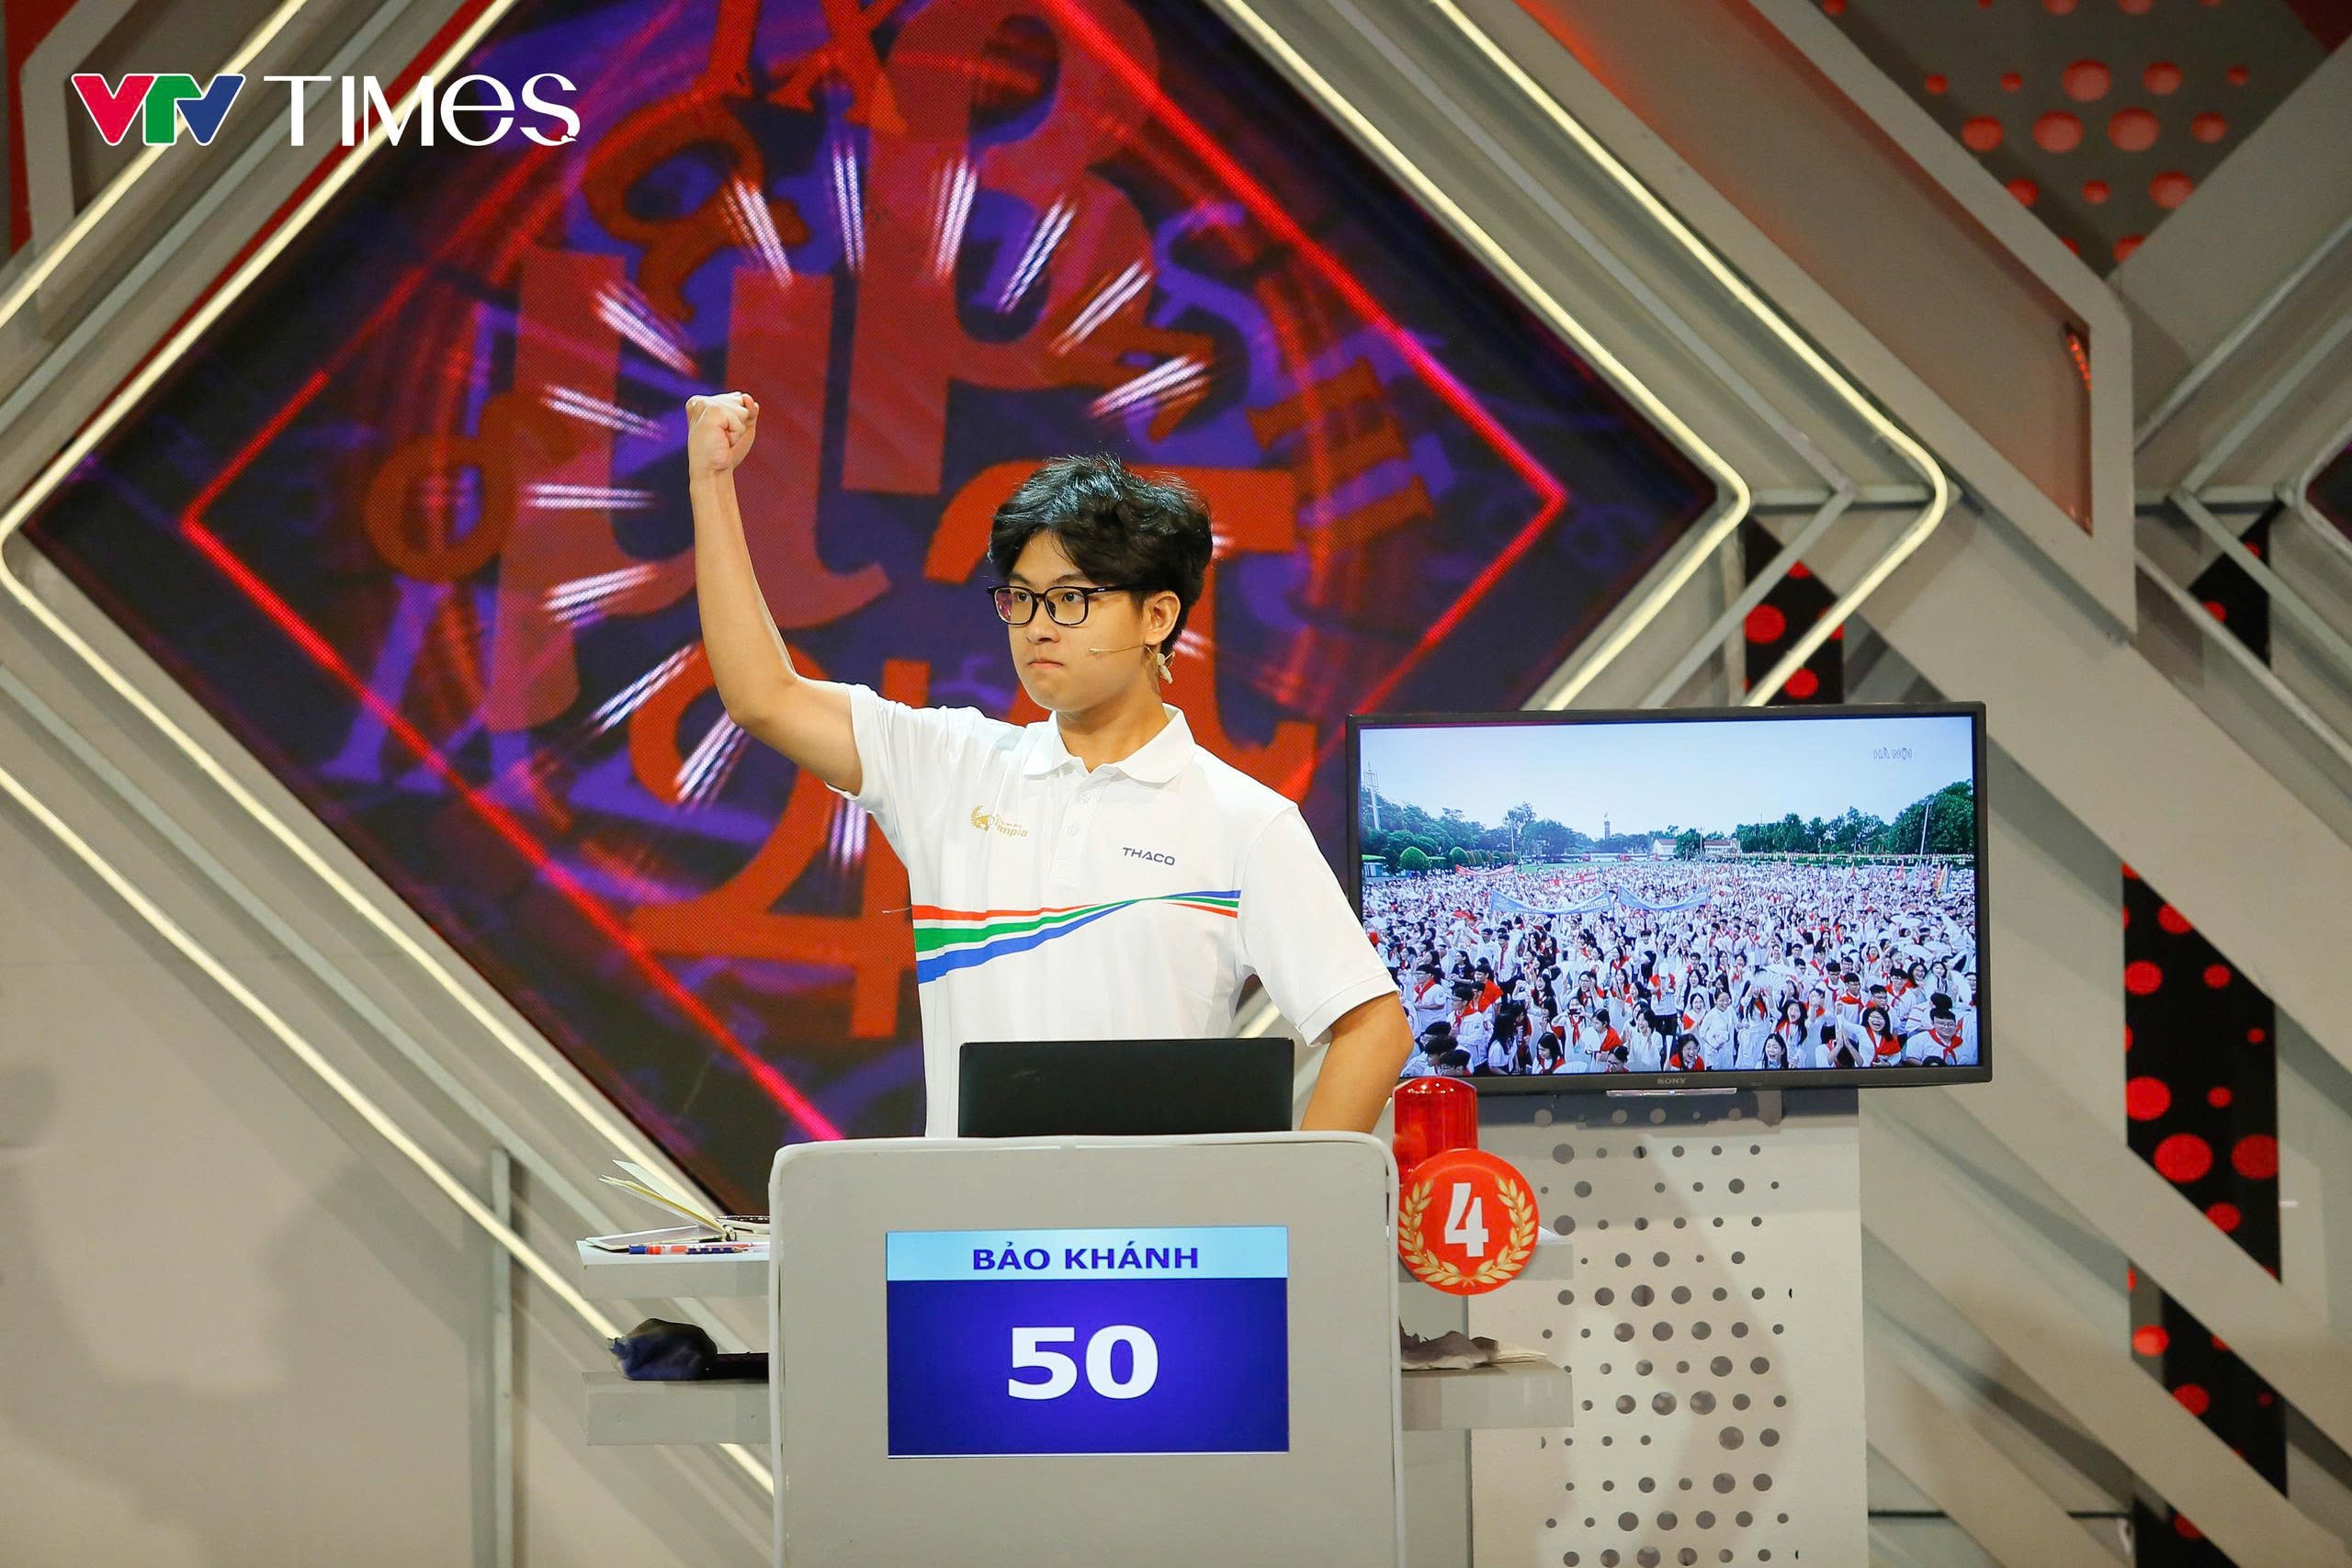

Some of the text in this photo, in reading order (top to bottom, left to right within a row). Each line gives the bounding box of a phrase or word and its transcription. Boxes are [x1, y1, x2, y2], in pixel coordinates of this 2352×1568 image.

[1122, 847, 1176, 866] THACO
[1444, 1182, 1489, 1258] 4
[972, 1240, 1199, 1270] BẢO KHÁNH
[1008, 1324, 1159, 1401] 50
